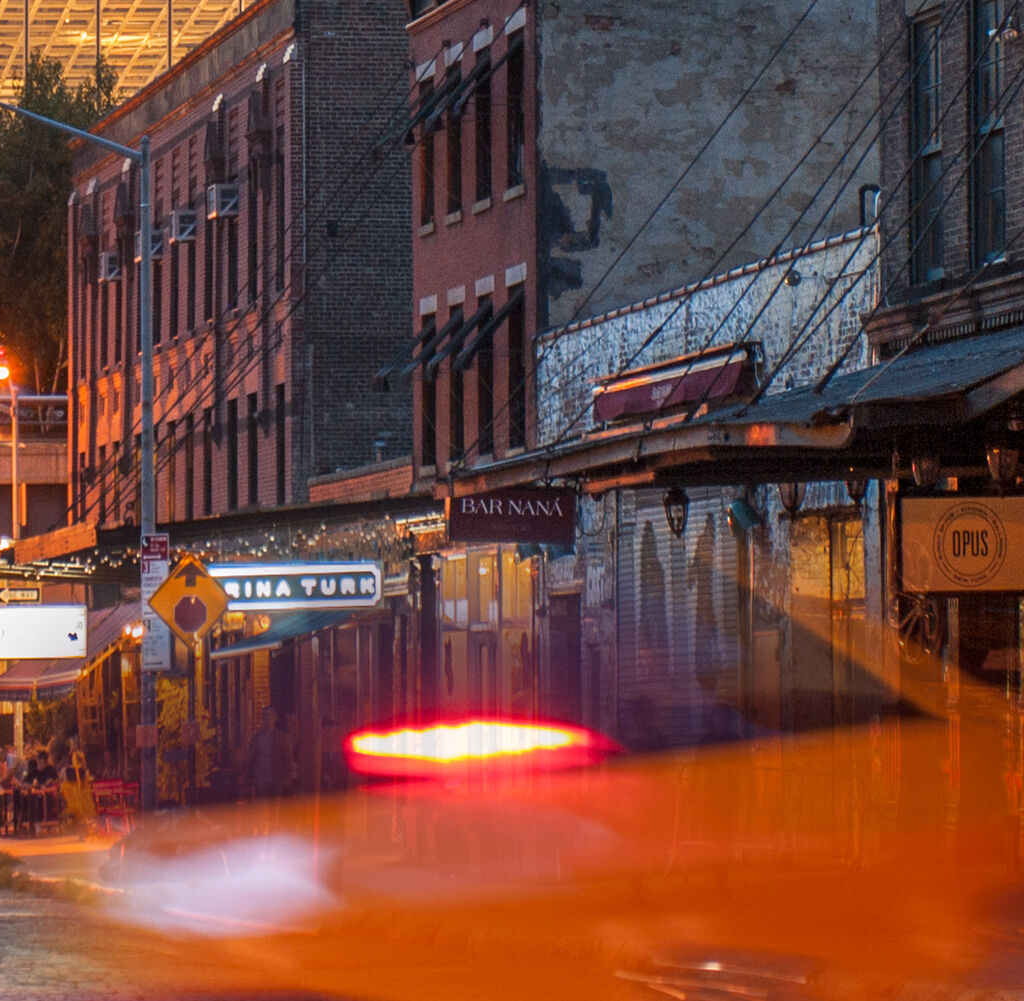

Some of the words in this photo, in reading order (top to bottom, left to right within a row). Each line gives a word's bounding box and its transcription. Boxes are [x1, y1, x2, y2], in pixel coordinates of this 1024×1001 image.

[462, 497, 503, 515] BAR
[508, 497, 563, 517] NANÁ
[952, 529, 989, 558] OPUS
[224, 579, 291, 599] RINA
[300, 576, 375, 597] TURK
